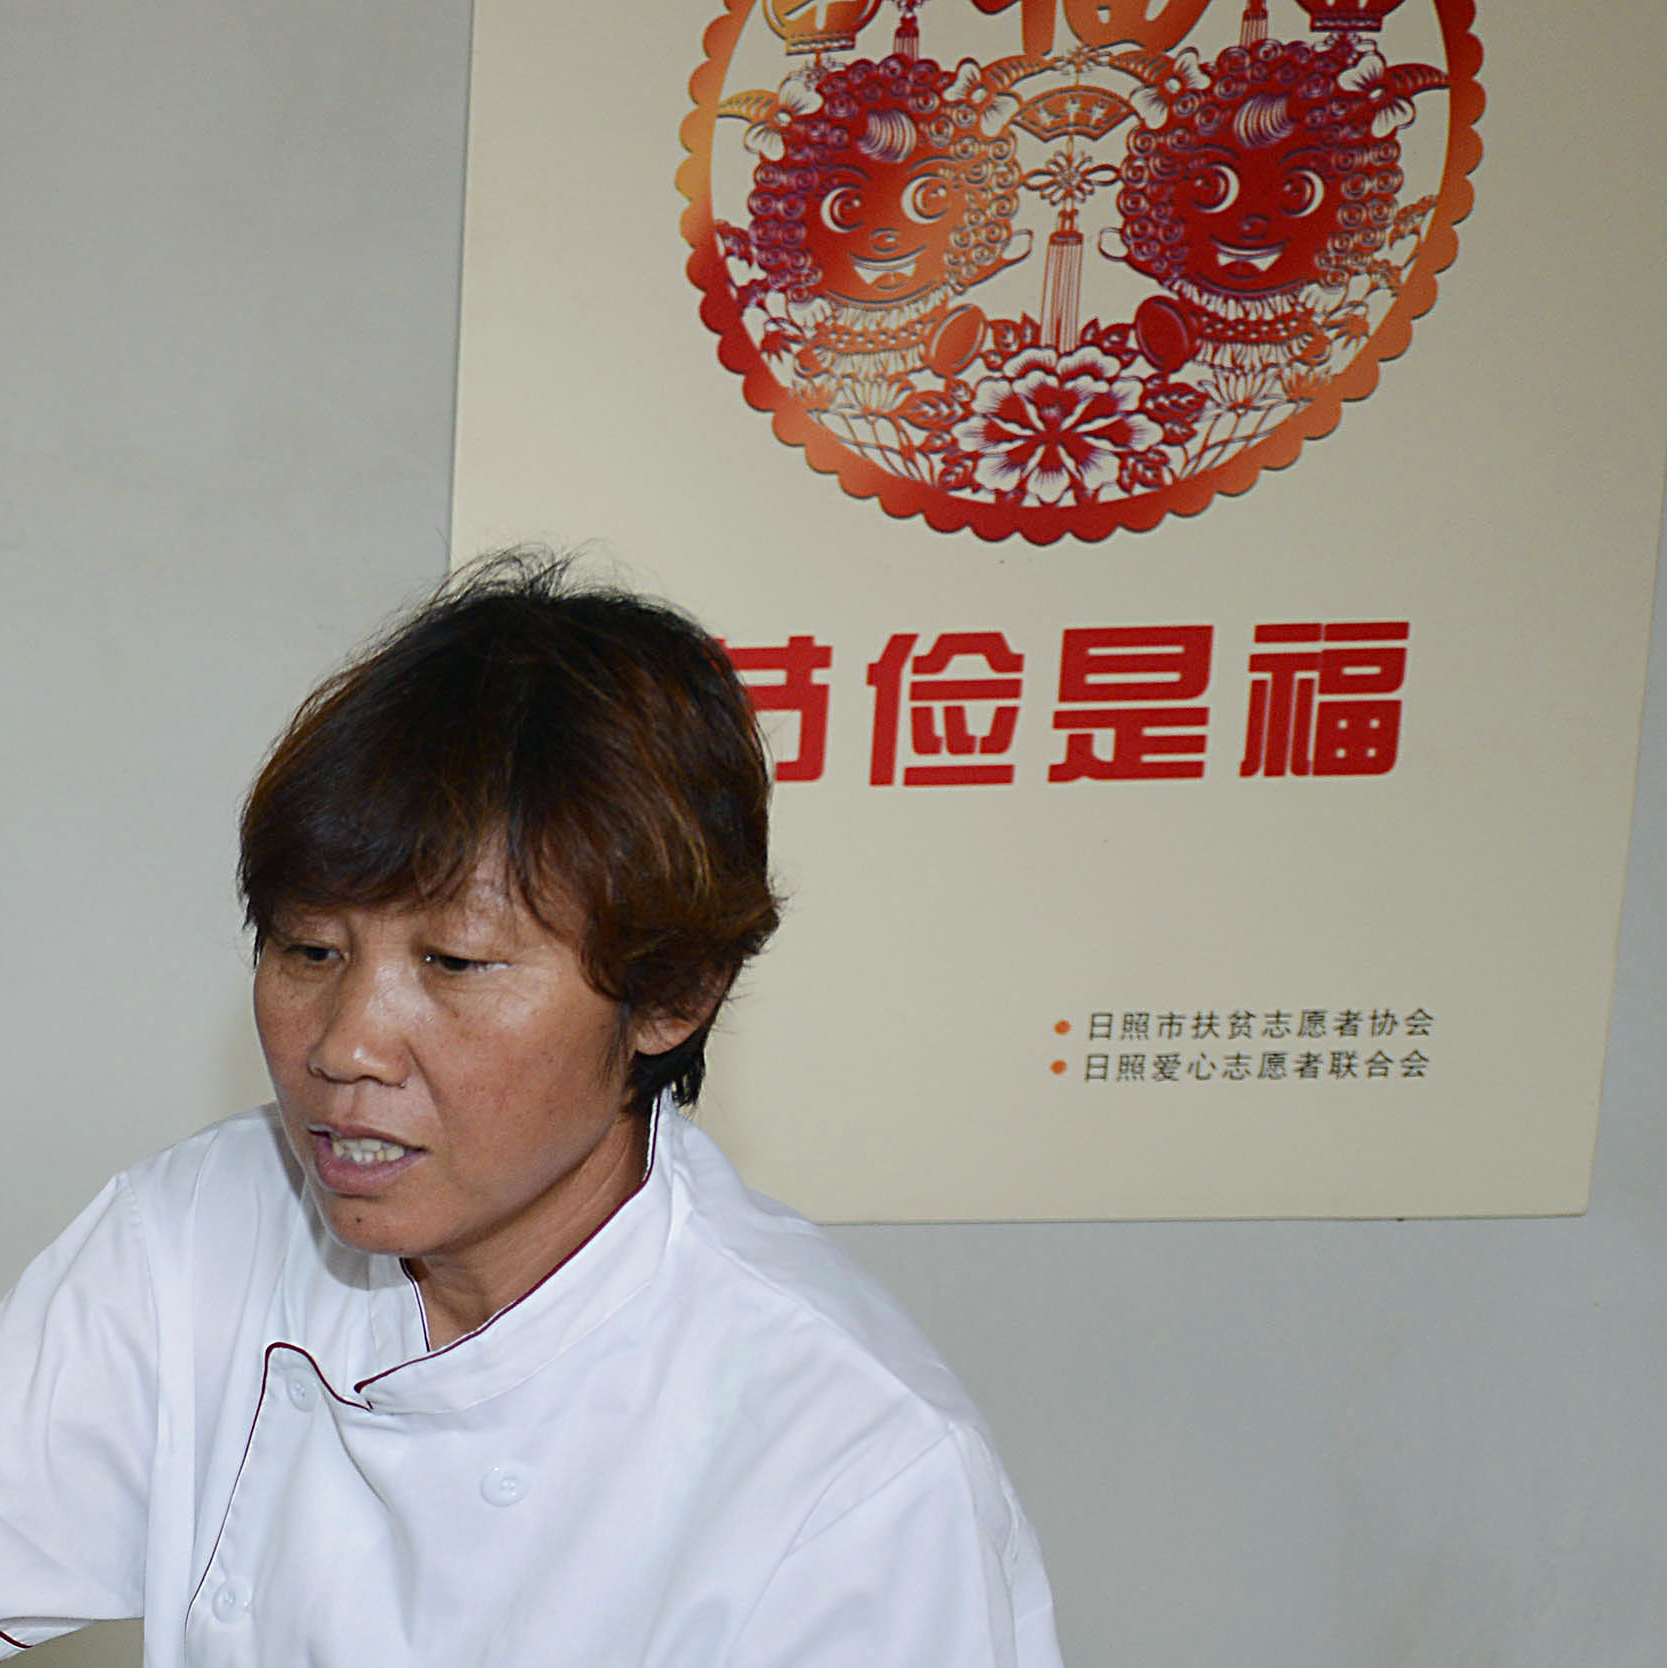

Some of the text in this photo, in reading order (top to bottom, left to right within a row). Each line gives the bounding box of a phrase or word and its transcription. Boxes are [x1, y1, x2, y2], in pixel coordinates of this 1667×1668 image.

[1088, 1007, 1436, 1041] 日照市扶贫志愿者协会
[1083, 1049, 1431, 1082] 日照爱心志愿者联合会
